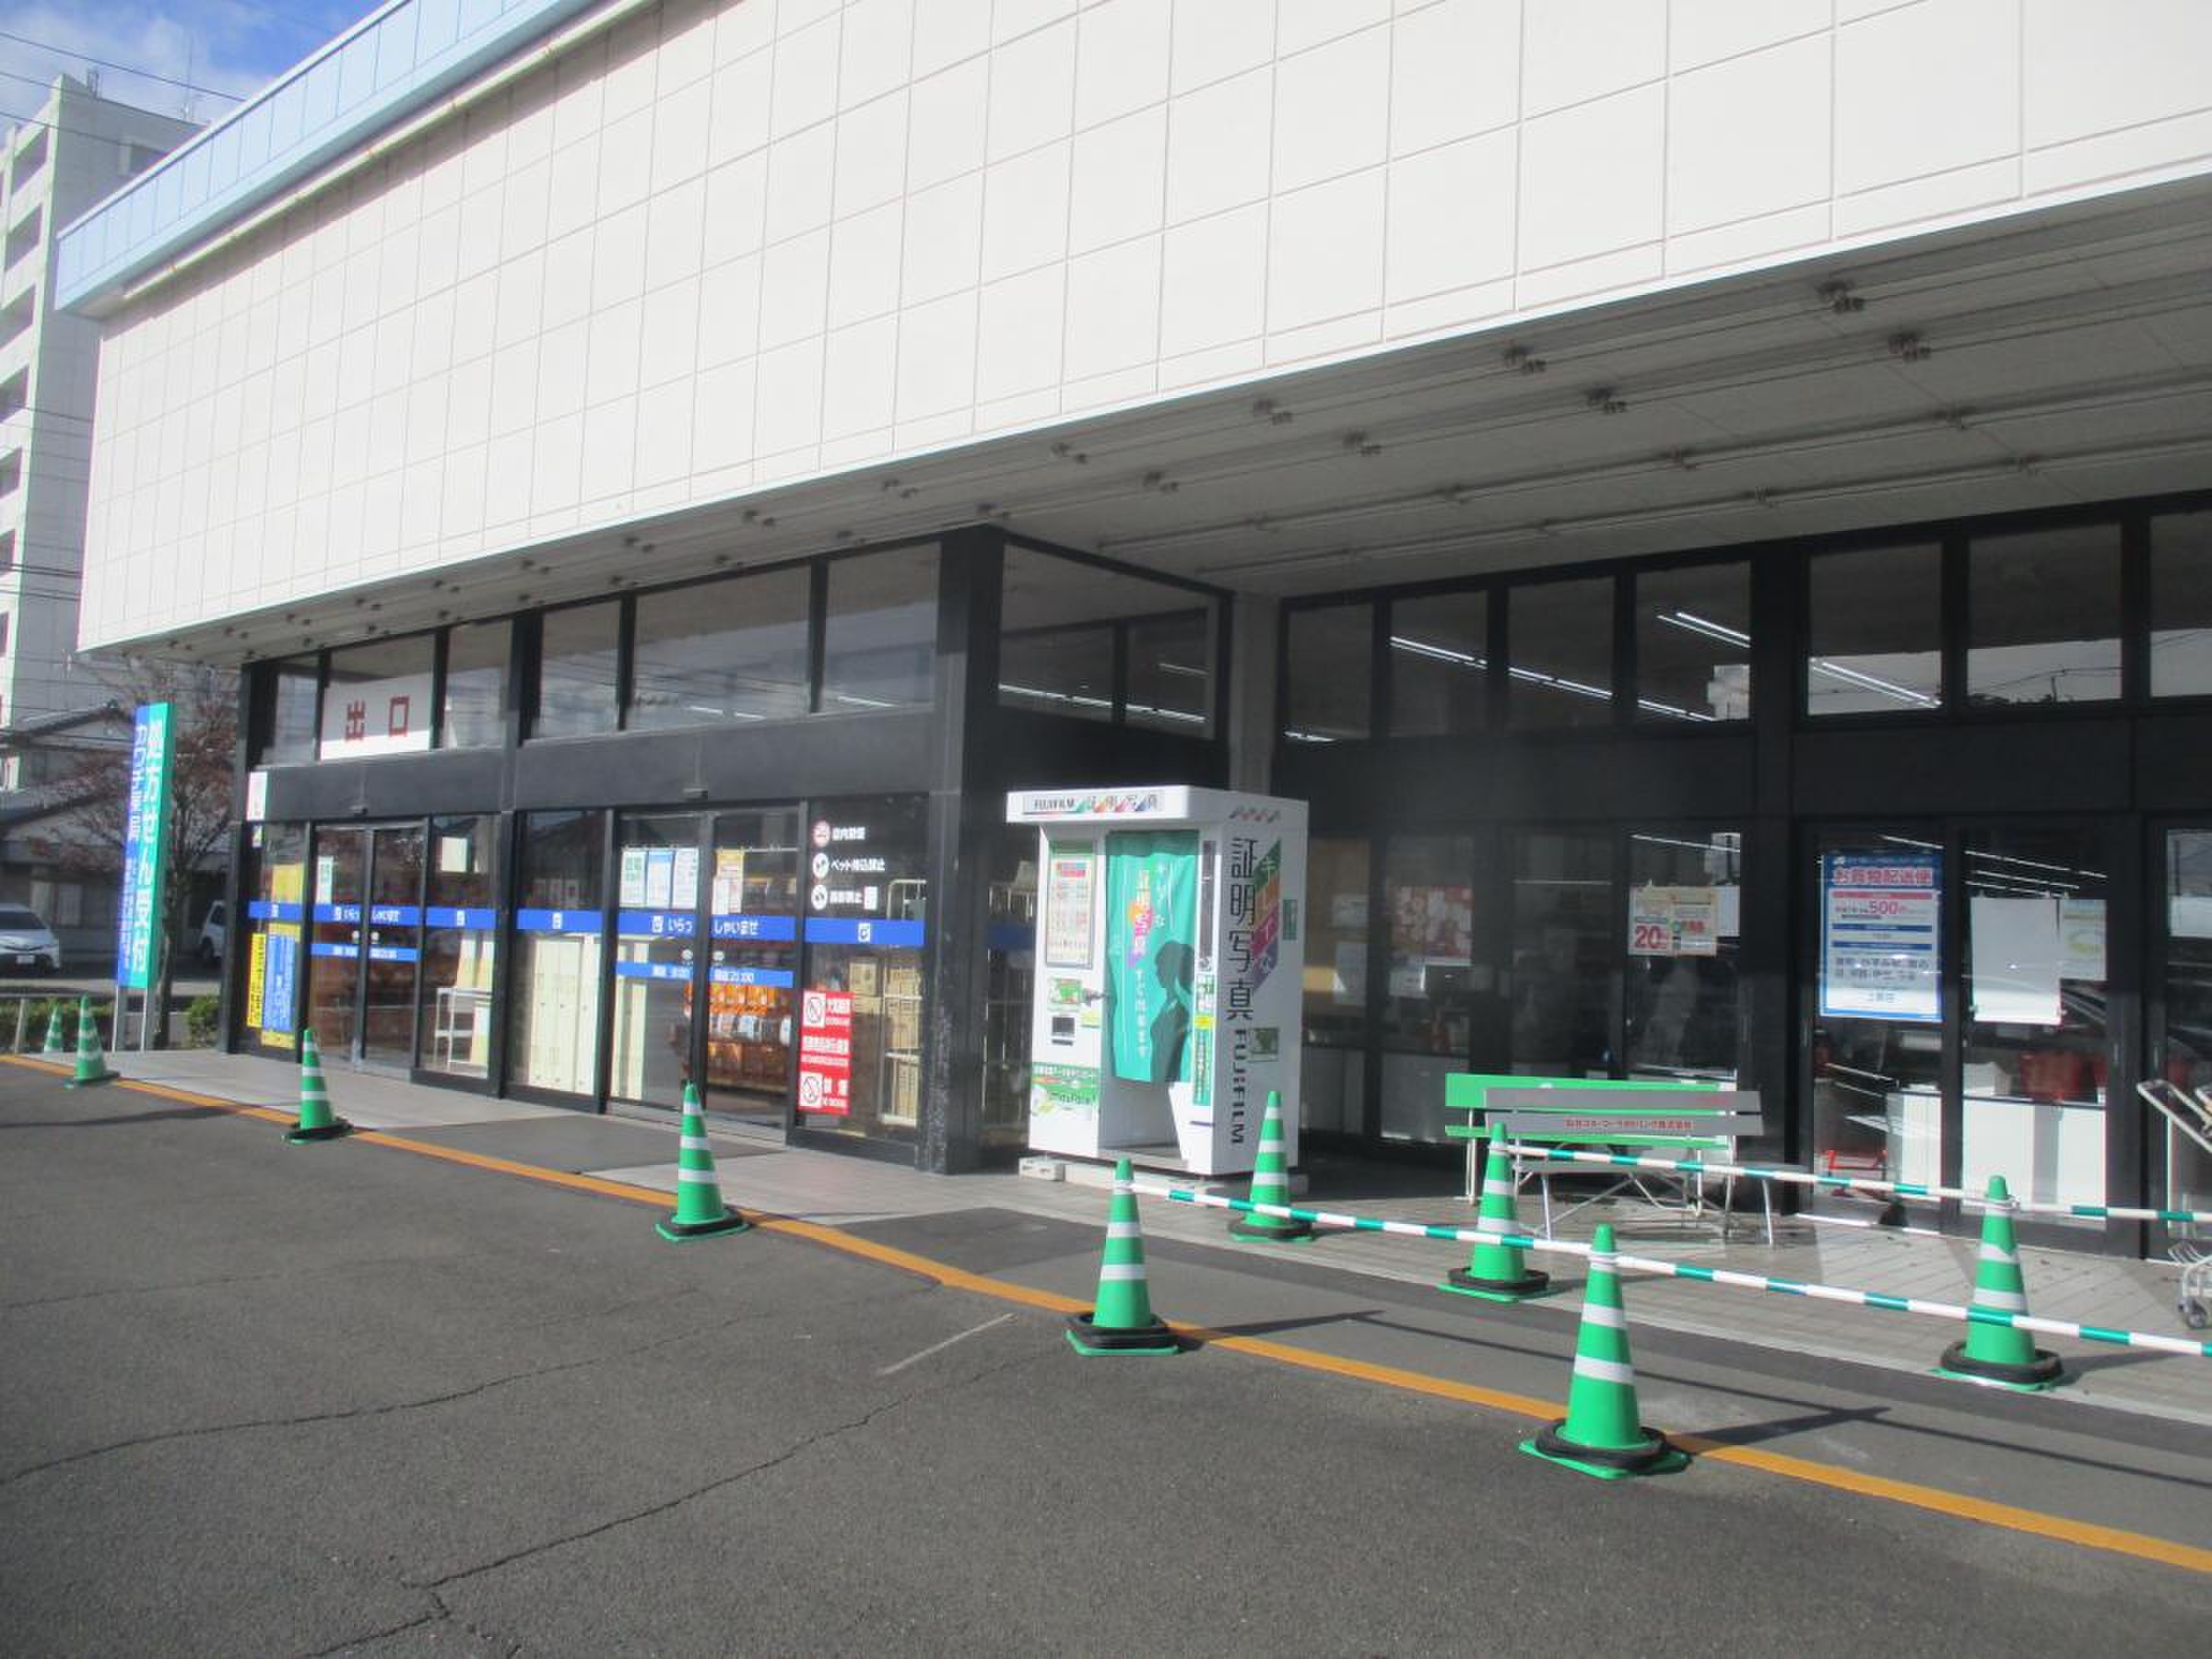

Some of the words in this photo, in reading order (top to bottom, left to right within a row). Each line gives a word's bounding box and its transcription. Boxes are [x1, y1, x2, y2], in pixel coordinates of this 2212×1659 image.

[345, 696, 410, 742] 出口
[1227, 838, 1255, 1020] 証明写真
[1230, 1029, 1247, 1144] FUJIFILM
